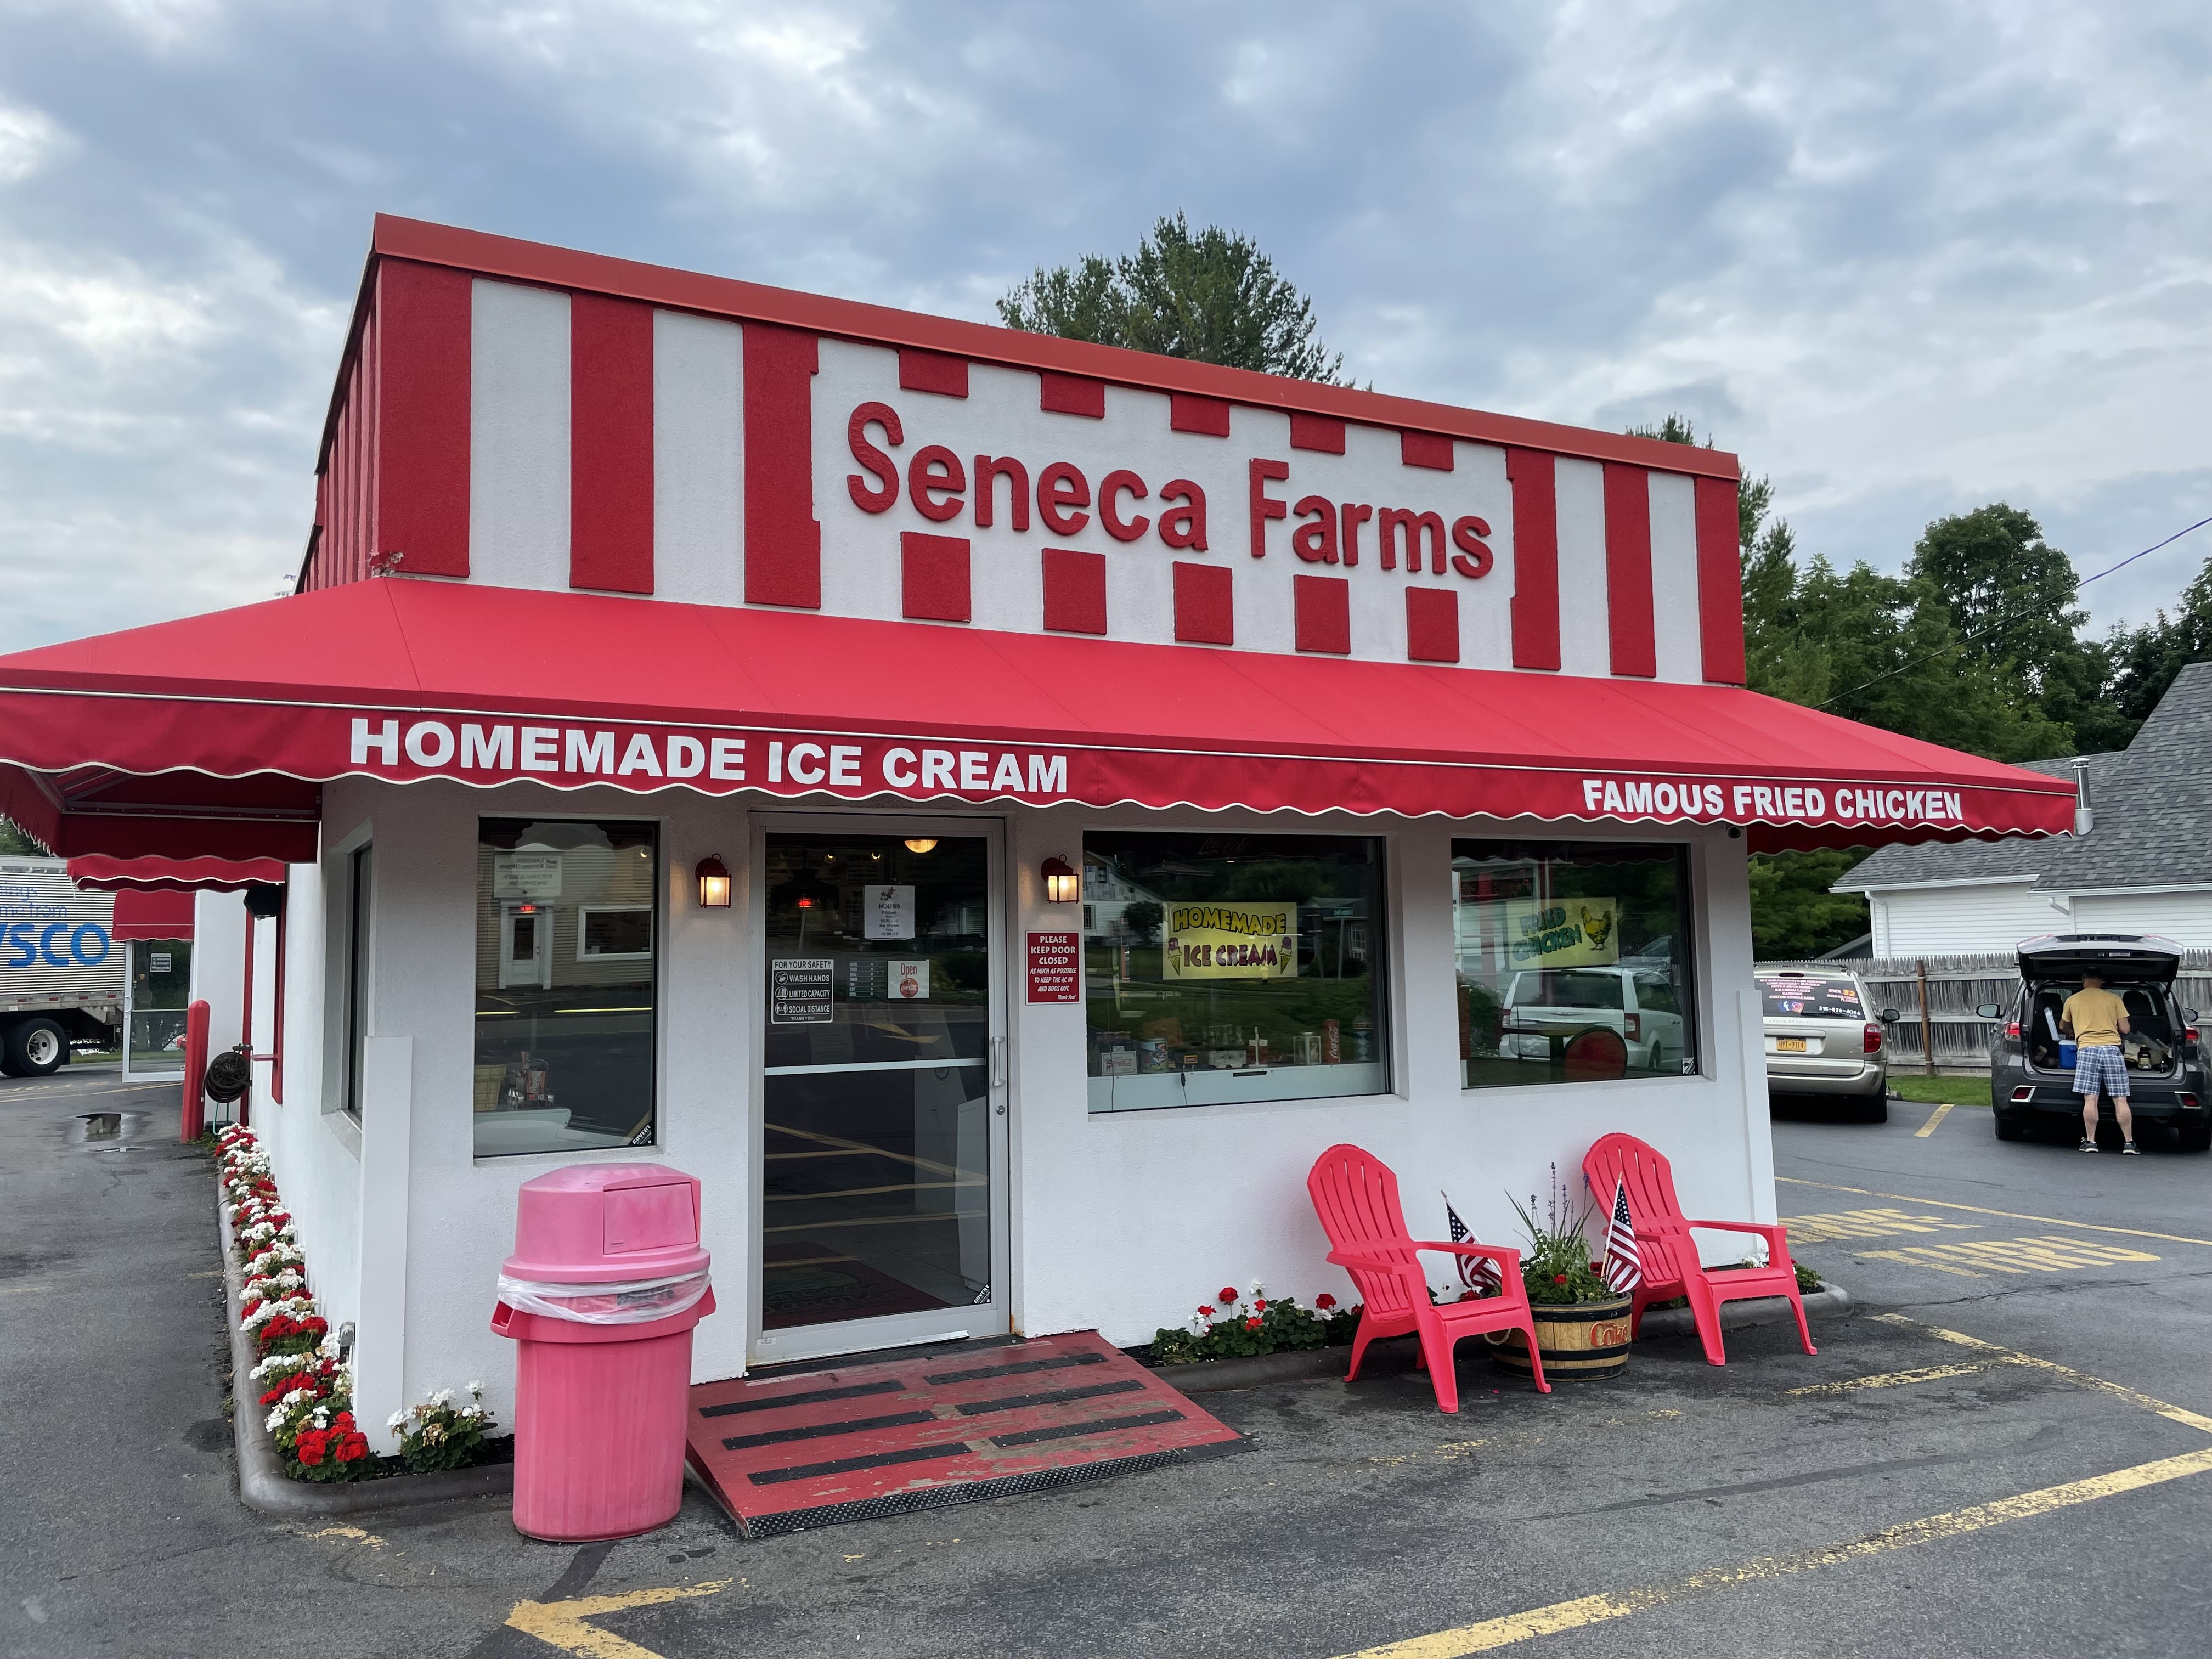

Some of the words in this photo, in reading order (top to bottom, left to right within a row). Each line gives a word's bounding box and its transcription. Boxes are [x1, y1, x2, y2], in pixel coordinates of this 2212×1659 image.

[847, 401, 1209, 550] Seneca
[1249, 458, 1493, 578] Farms
[350, 718, 746, 781] HOMEMADE
[768, 742, 862, 786] ICE
[882, 747, 1067, 793] CREAM
[1582, 780, 1724, 816] FAMOUS
[1733, 786, 1825, 818] FRIED
[1835, 789, 1963, 821] CHICKEN
[0, 881, 38, 902] ings
[30, 902, 67, 917] from
[1173, 907, 1286, 936] HOMEMADE
[1519, 906, 1566, 936] FRIED
[1184, 944, 1211, 967] ICE
[1216, 944, 1278, 967] CREAM
[1512, 924, 1582, 961] CHICKEN
[900, 963, 917, 978] Open
[632, 1124, 651, 1144] COVERT
[1853, 1235, 2162, 1278] THRU
[1590, 1322, 1628, 1347] Coke
